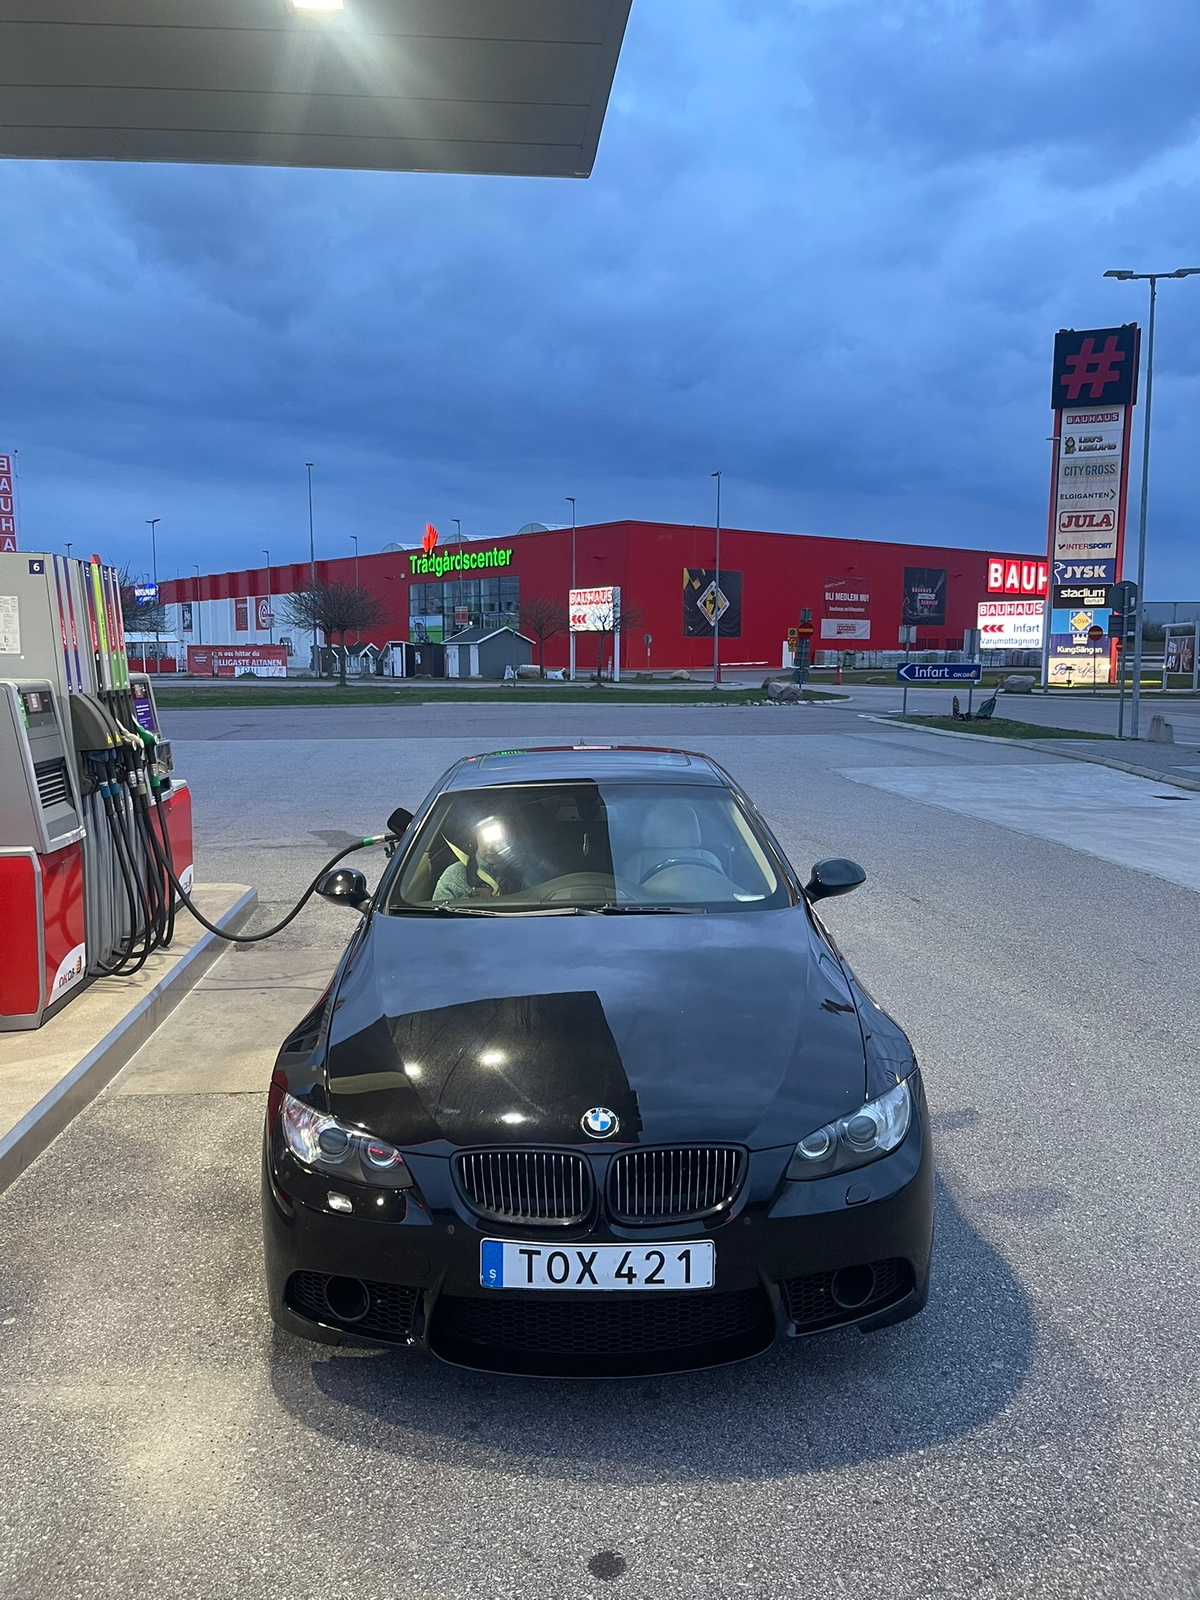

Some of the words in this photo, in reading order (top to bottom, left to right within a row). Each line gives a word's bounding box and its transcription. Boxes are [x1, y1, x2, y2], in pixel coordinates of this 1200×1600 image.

[1066, 412, 1119, 425] BAUHAUS
[1064, 465, 1084, 477] CITY
[1085, 463, 1116, 476] GROSS
[1060, 491, 1110, 501] ELGIGANTEN
[1061, 513, 1112, 529] JULA
[1066, 542, 1113, 551] INTERSPORT
[32, 563, 40, 572] 6
[409, 547, 513, 577] Trädgårdscenter
[1063, 565, 1107, 579] JYSK
[1060, 587, 1106, 598] stadium
[979, 602, 1044, 616] BAUHAUS
[1012, 623, 1040, 633] Infart
[251, 659, 282, 667] ALTANEN
[914, 665, 950, 678] Infart
[518, 1248, 599, 1285] TOX
[614, 1249, 692, 1285] 421
[489, 1268, 497, 1279] S
